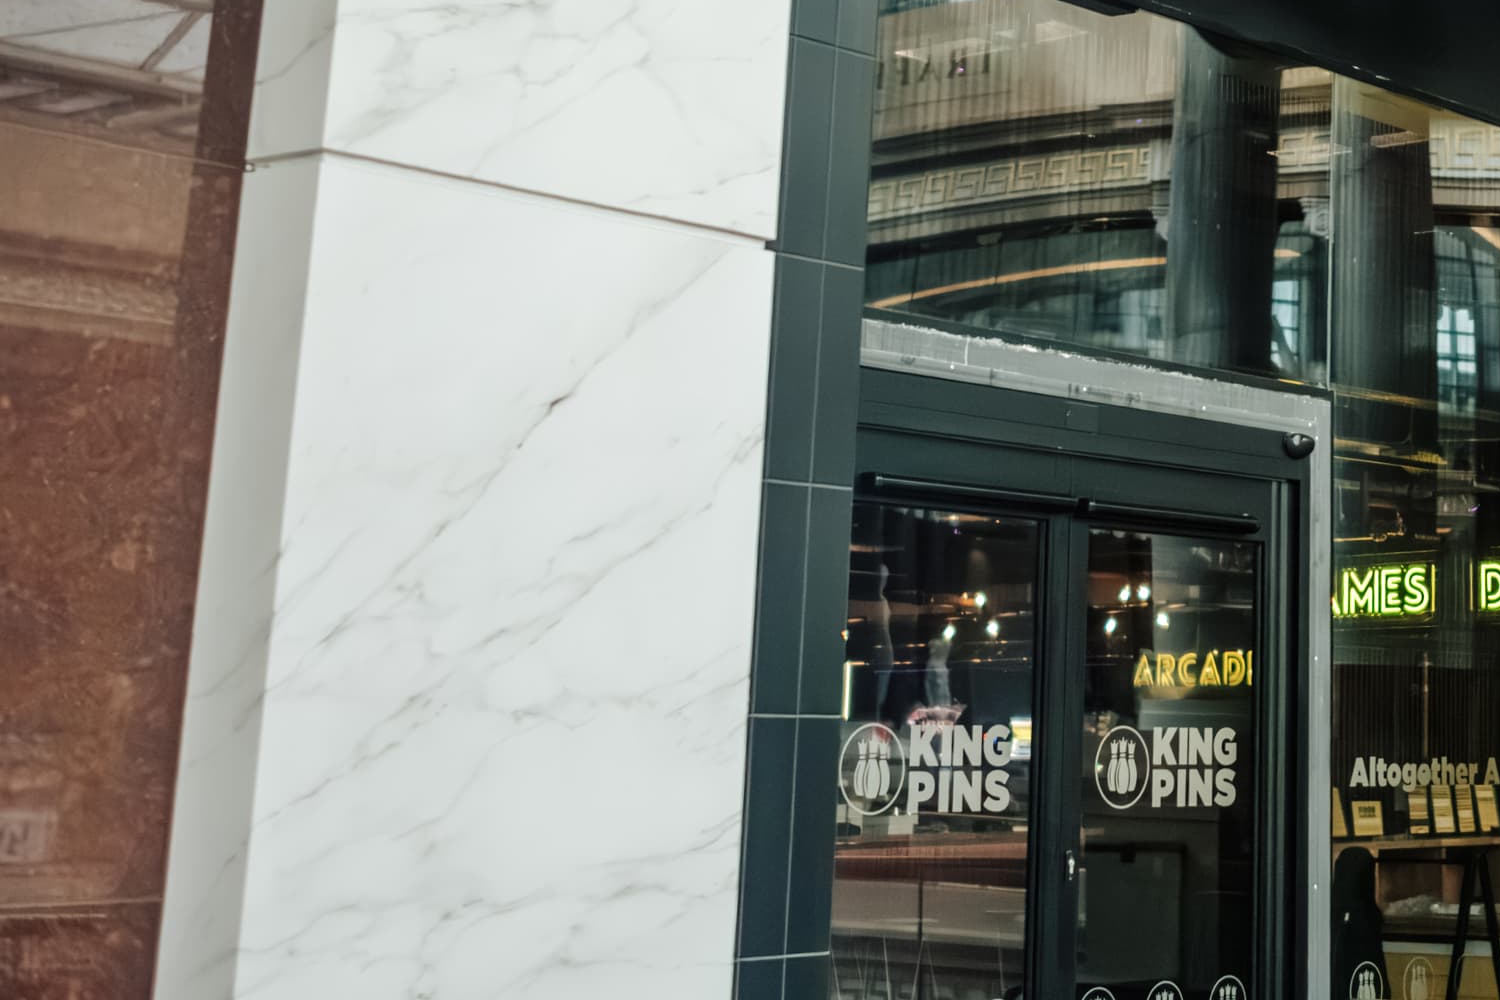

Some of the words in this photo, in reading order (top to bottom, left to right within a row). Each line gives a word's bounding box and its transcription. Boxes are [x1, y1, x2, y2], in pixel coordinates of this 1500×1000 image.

[909, 724, 1011, 767] KING
[1152, 726, 1237, 766] KING
[907, 769, 1010, 813] PINS
[1151, 768, 1237, 808] PINS
[1350, 756, 1478, 792] Altogether
[1484, 757, 1500, 785] A
